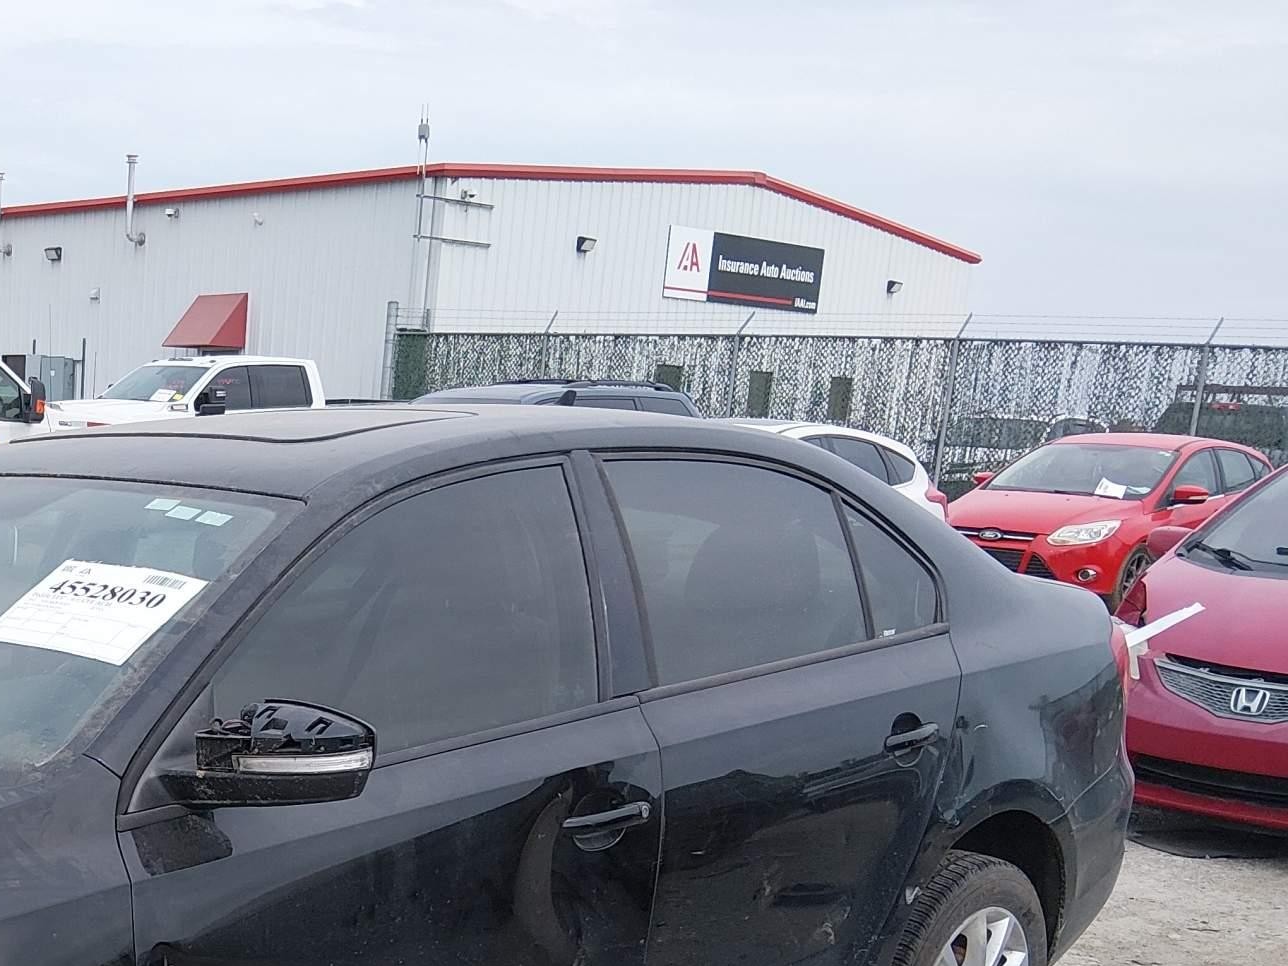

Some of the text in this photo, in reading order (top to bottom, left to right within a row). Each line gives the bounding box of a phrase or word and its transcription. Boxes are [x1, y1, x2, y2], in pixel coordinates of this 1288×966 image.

[718, 254, 815, 284] Insurance Auto Auctions
[49, 578, 167, 609] 45528030
